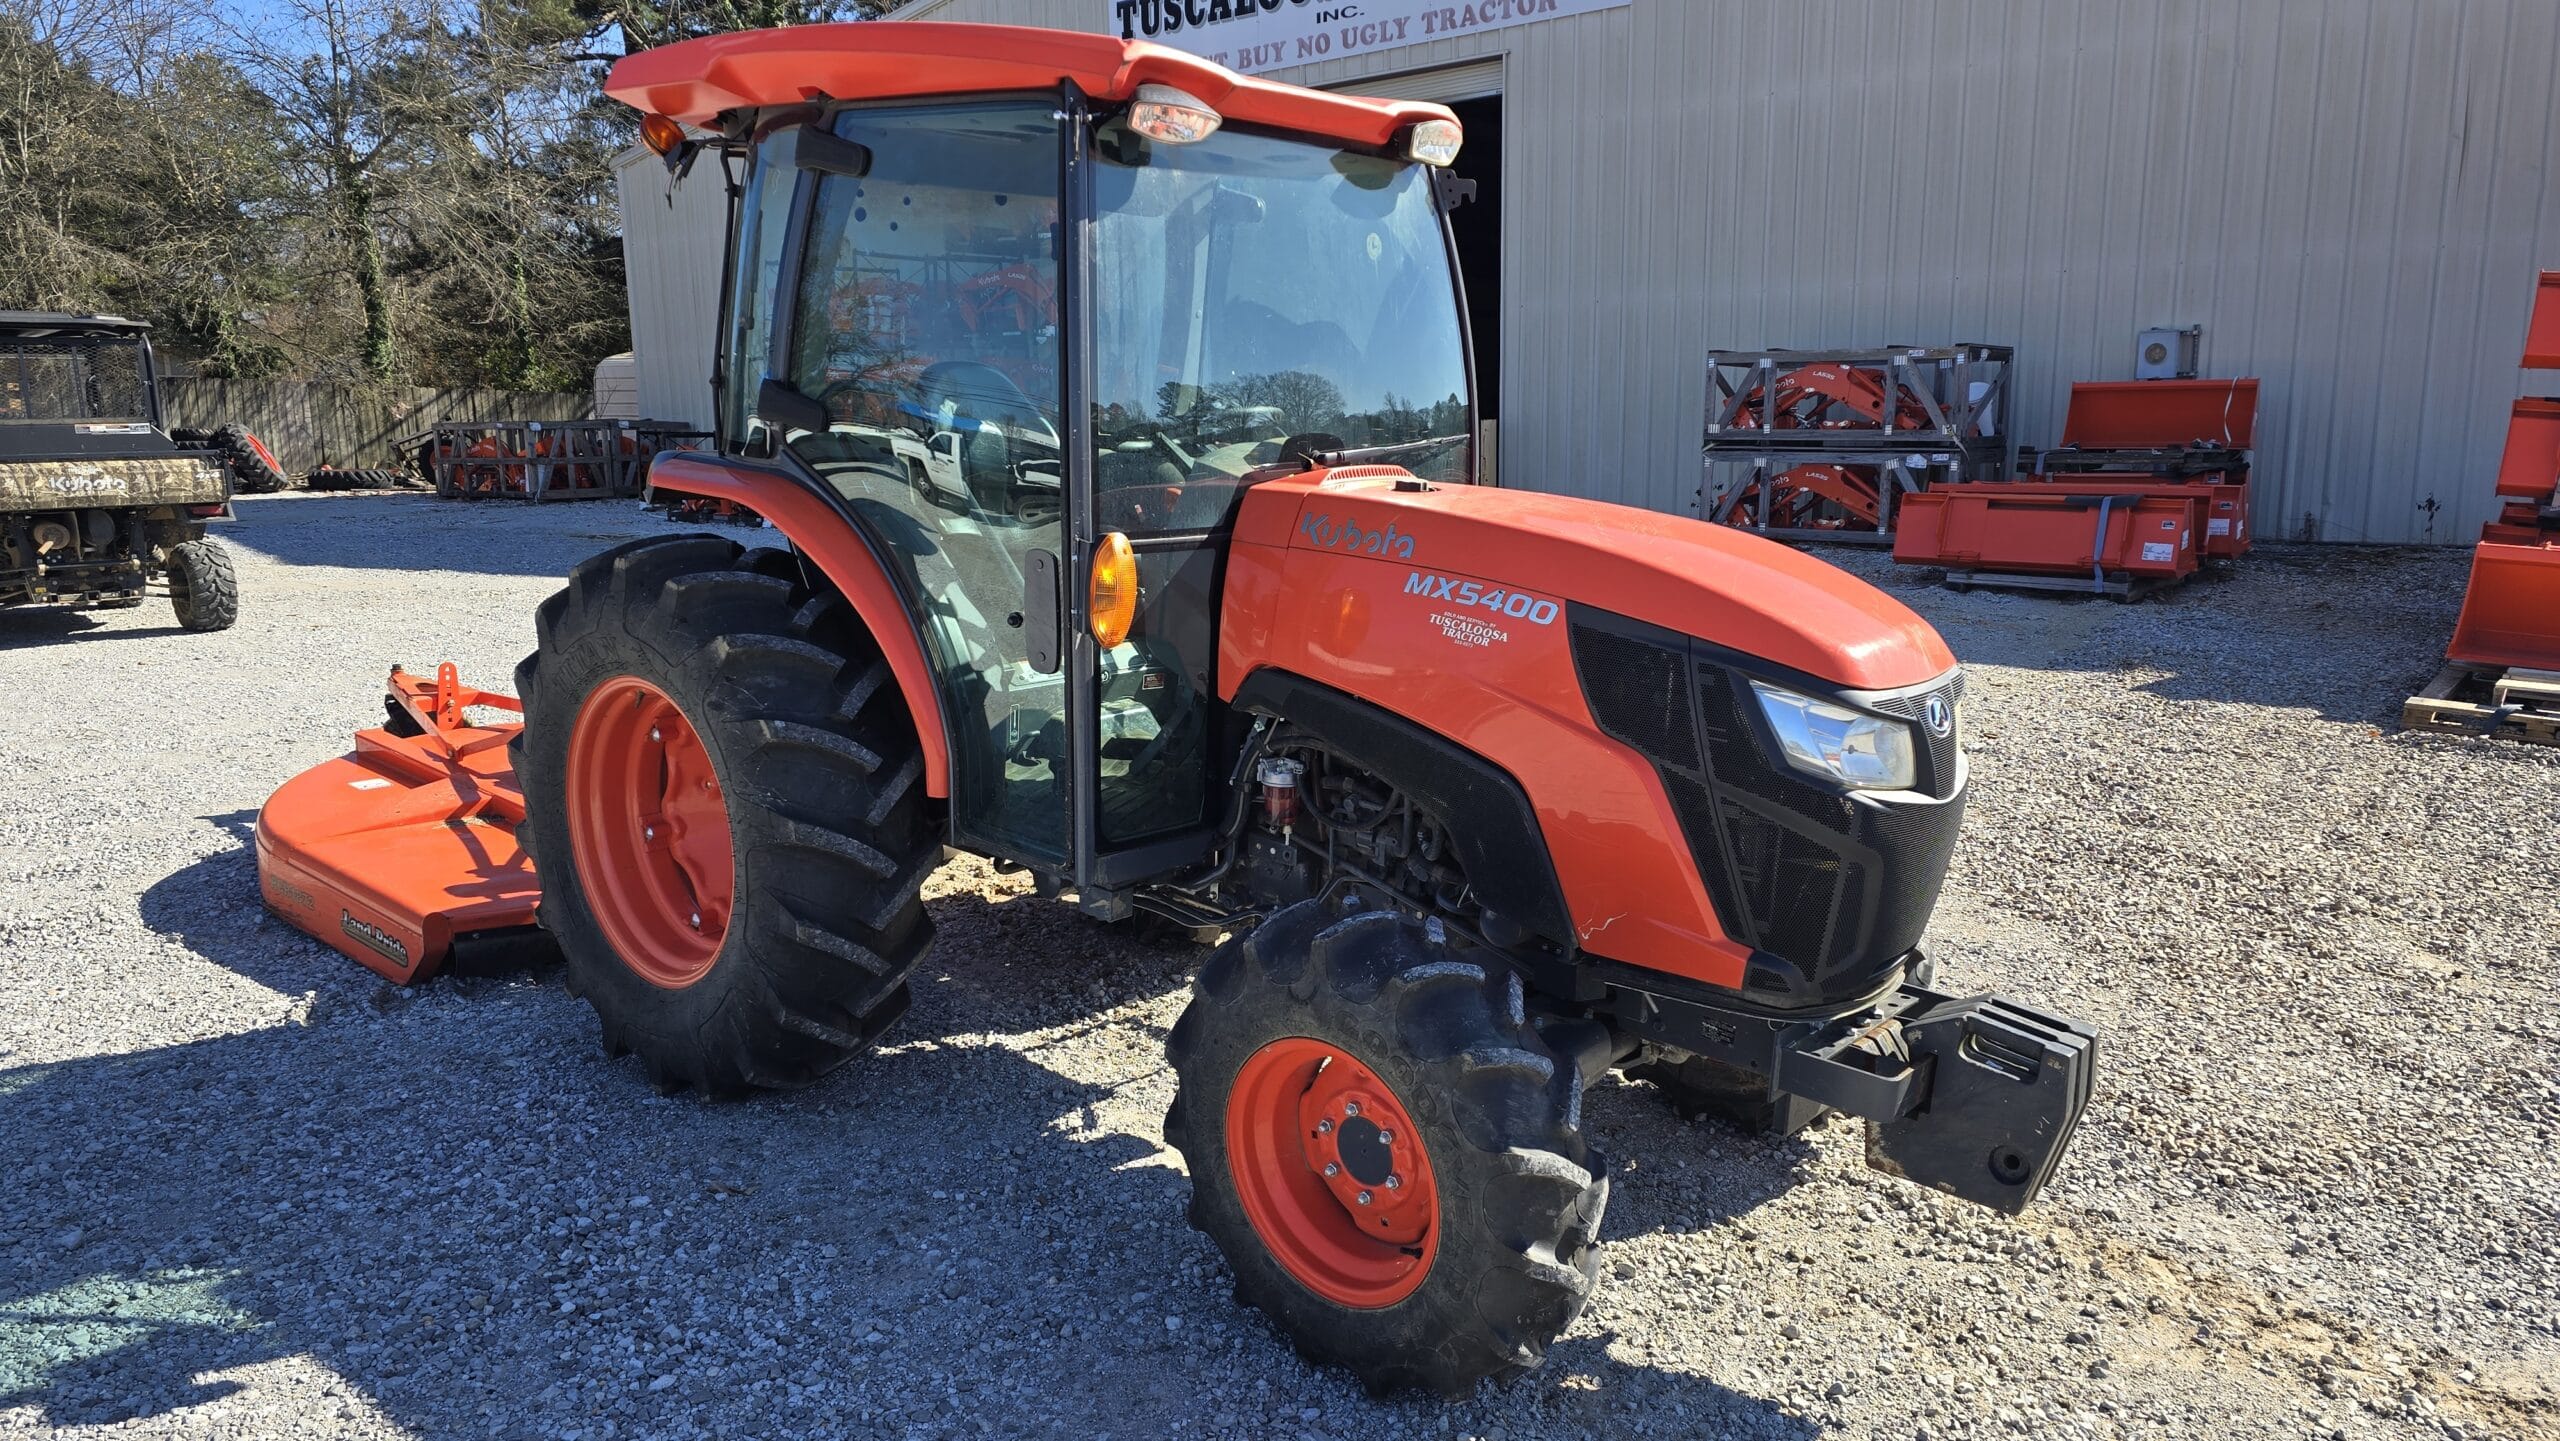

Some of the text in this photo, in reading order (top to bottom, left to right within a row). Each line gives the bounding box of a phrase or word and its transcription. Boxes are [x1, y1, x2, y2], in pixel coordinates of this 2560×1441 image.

[1116, 0, 1332, 40] TUSCA
[1238, 41, 1286, 69] BUY
[1296, 32, 1331, 59] NO
[1341, 15, 1410, 49] UGLY
[1422, 0, 1557, 34] TRACTOR
[1316, 5, 1365, 24] INC.
[49, 475, 126, 491] Kubota
[1300, 511, 1416, 559] Kubota
[1403, 571, 1560, 626] MX5400
[1429, 613, 1508, 643] TUSCALOOSA
[1442, 626, 1490, 647] TRACTOR
[342, 908, 407, 956] Land Pride
